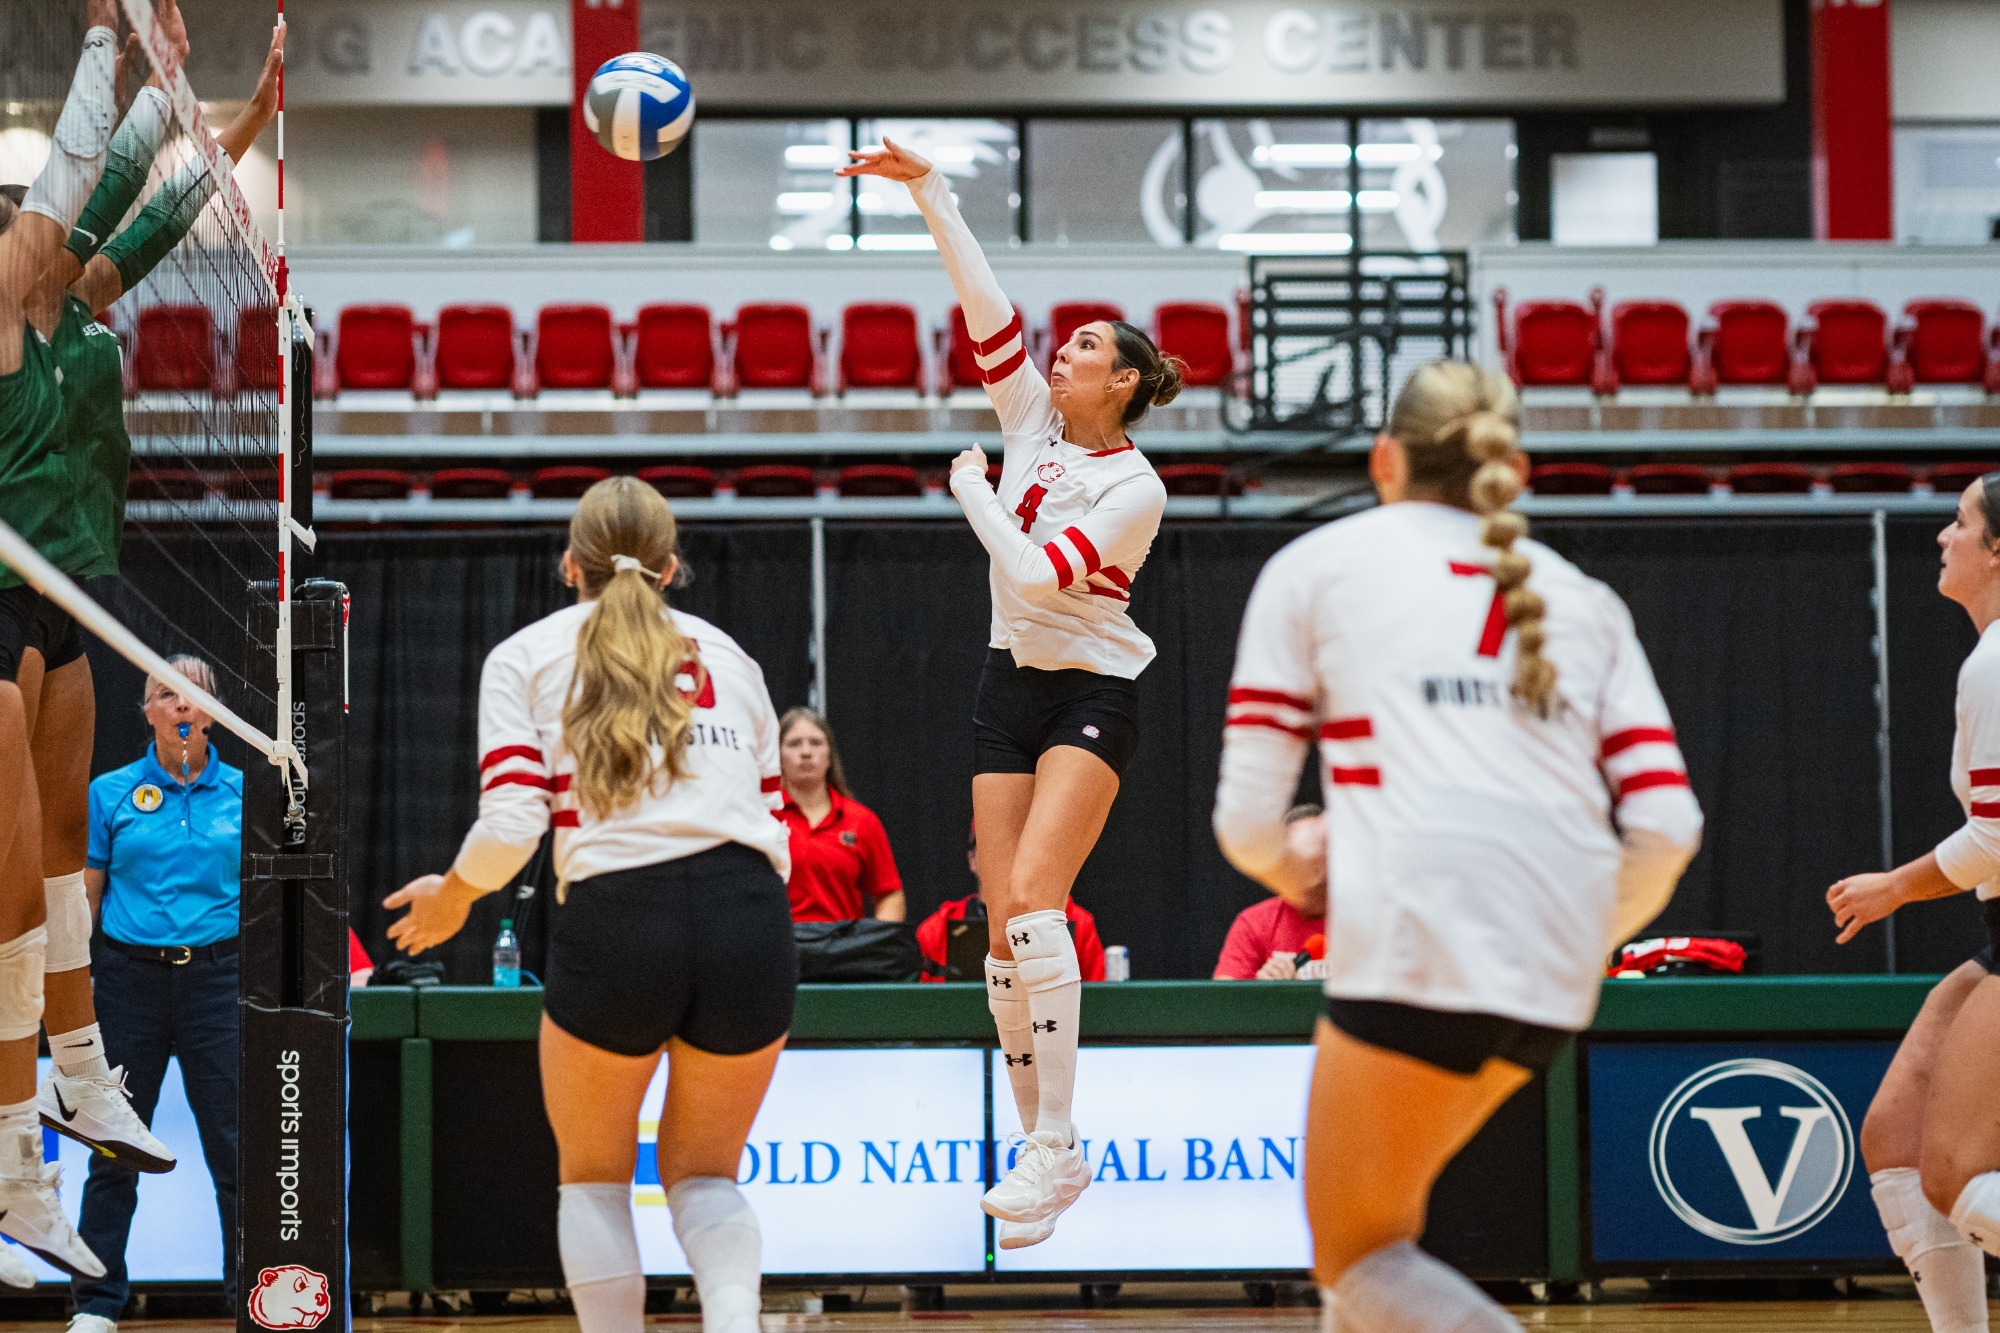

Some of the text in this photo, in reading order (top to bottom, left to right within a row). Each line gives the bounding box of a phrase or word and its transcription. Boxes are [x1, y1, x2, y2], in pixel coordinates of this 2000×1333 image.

[855, 11, 1234, 74] SUCCESS
[1263, 10, 1580, 73] CENTER
[1015, 483, 1048, 534] 4
[1448, 561, 1508, 658] 7
[276, 1050, 302, 1241] sports imports
[860, 1138, 1167, 1183] NATIAL
[1183, 1137, 1300, 1182] BAN
[1689, 1106, 1829, 1231] V
